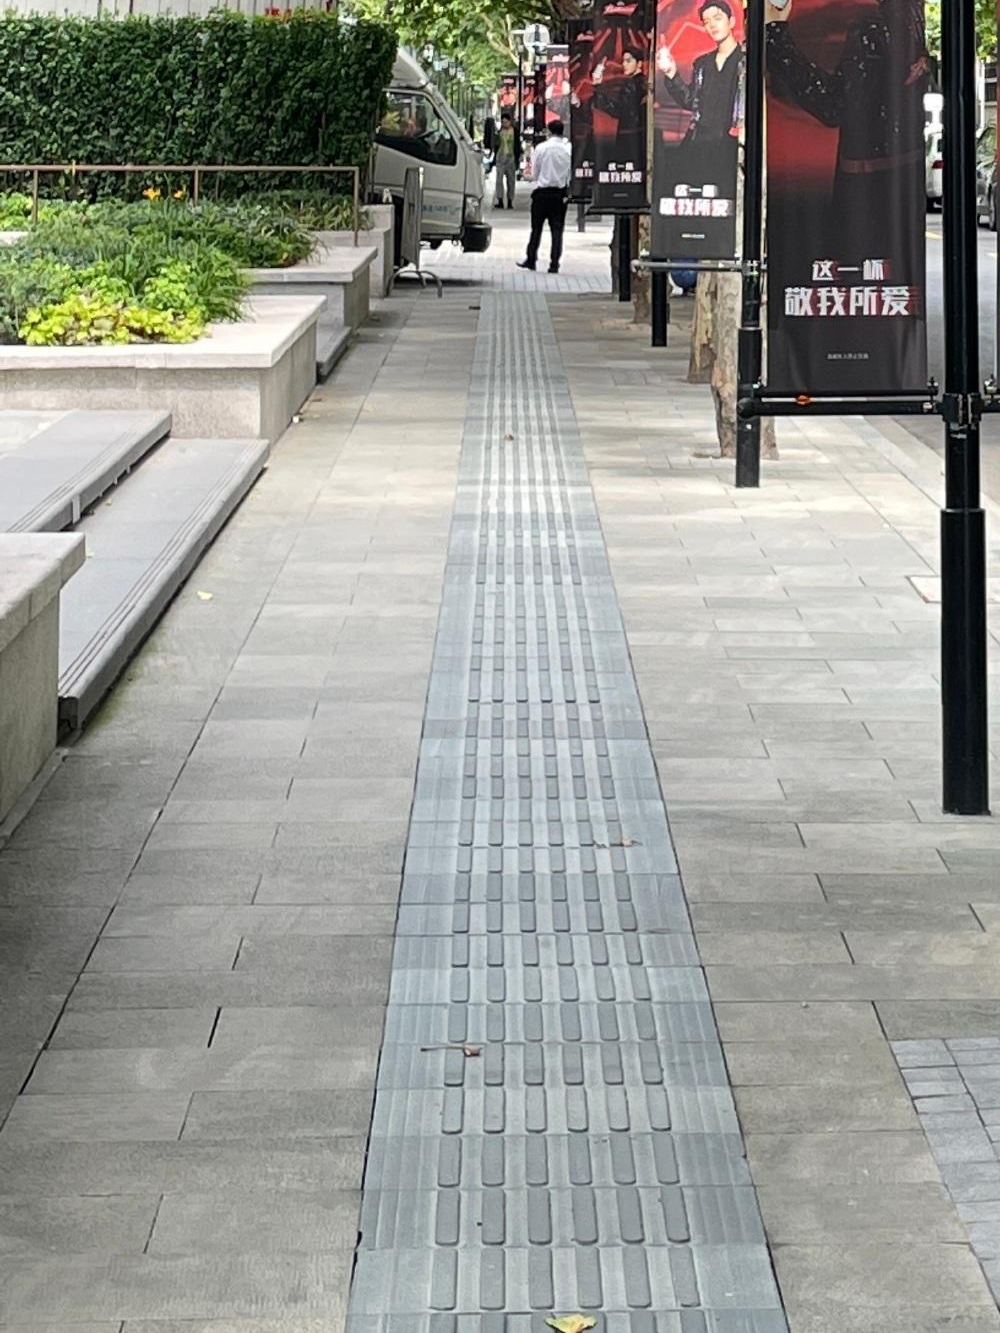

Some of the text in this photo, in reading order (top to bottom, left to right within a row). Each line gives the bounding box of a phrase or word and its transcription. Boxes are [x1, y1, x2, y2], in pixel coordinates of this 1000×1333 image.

[812, 259, 888, 281] 这一杯
[784, 285, 914, 316] 敬我所爱
